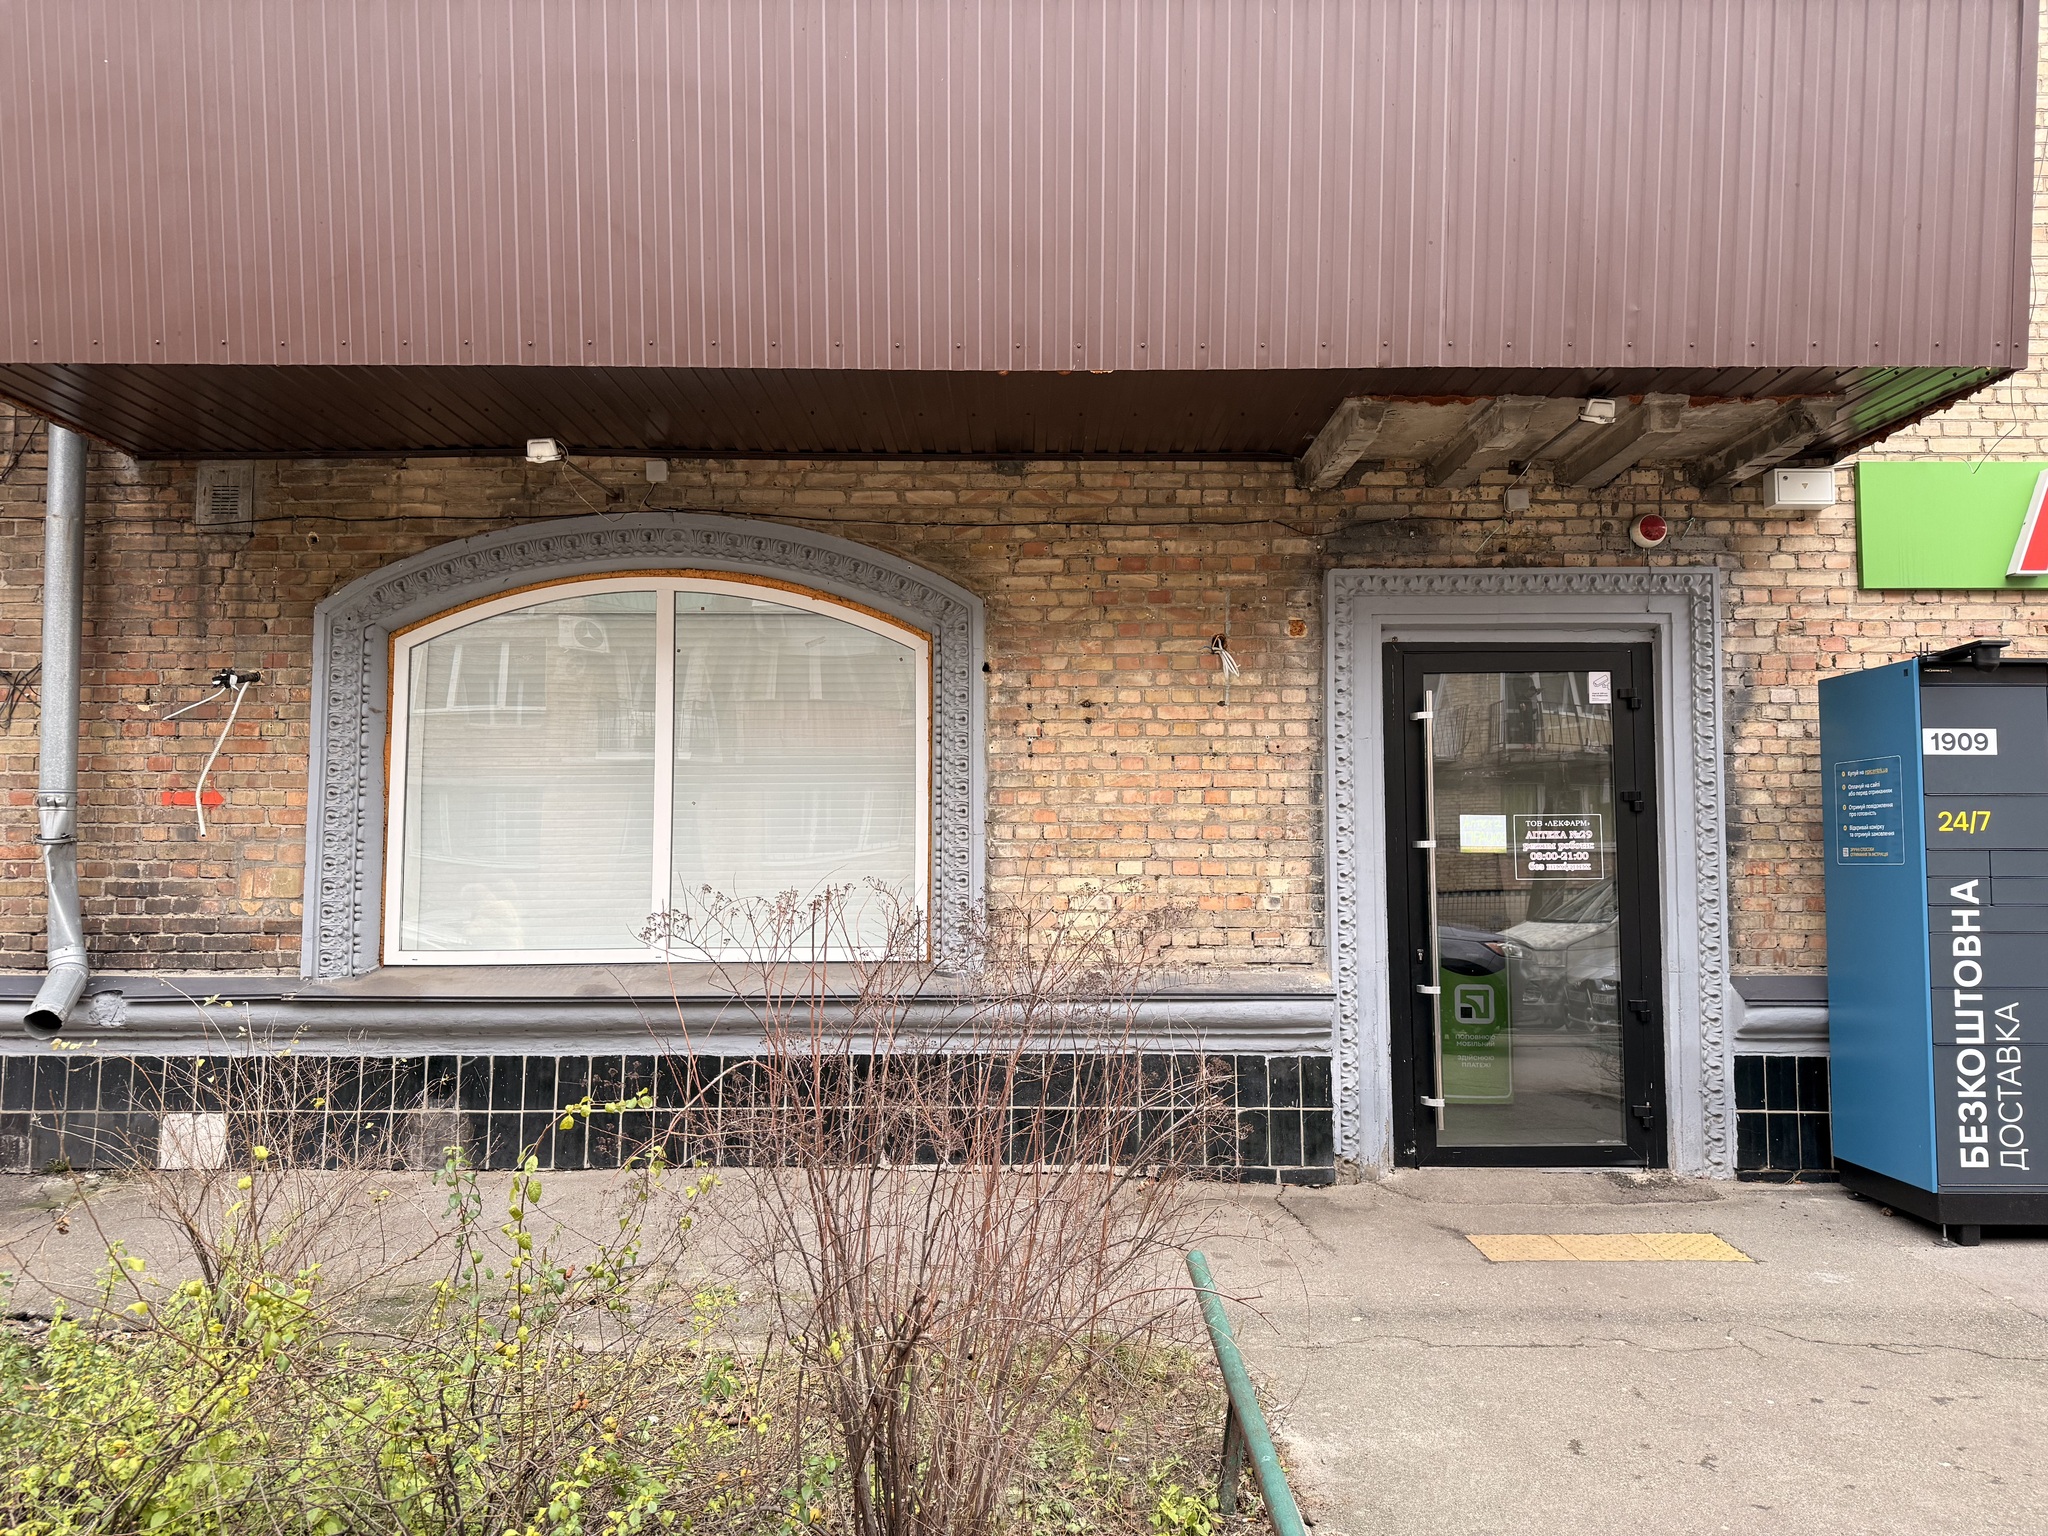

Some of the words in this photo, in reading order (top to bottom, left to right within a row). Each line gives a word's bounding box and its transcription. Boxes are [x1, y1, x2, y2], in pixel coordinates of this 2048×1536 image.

[1930, 732, 1989, 751] 1909
[1937, 810, 1991, 835] 24/7
[1525, 830, 1568, 839] АПТЕКА
[1529, 852, 1590, 861] 08:00-21:00
[1950, 878, 1990, 1169] БЕЗКОШТОВНА
[1994, 1001, 2030, 1171] ДОСТАВКА
